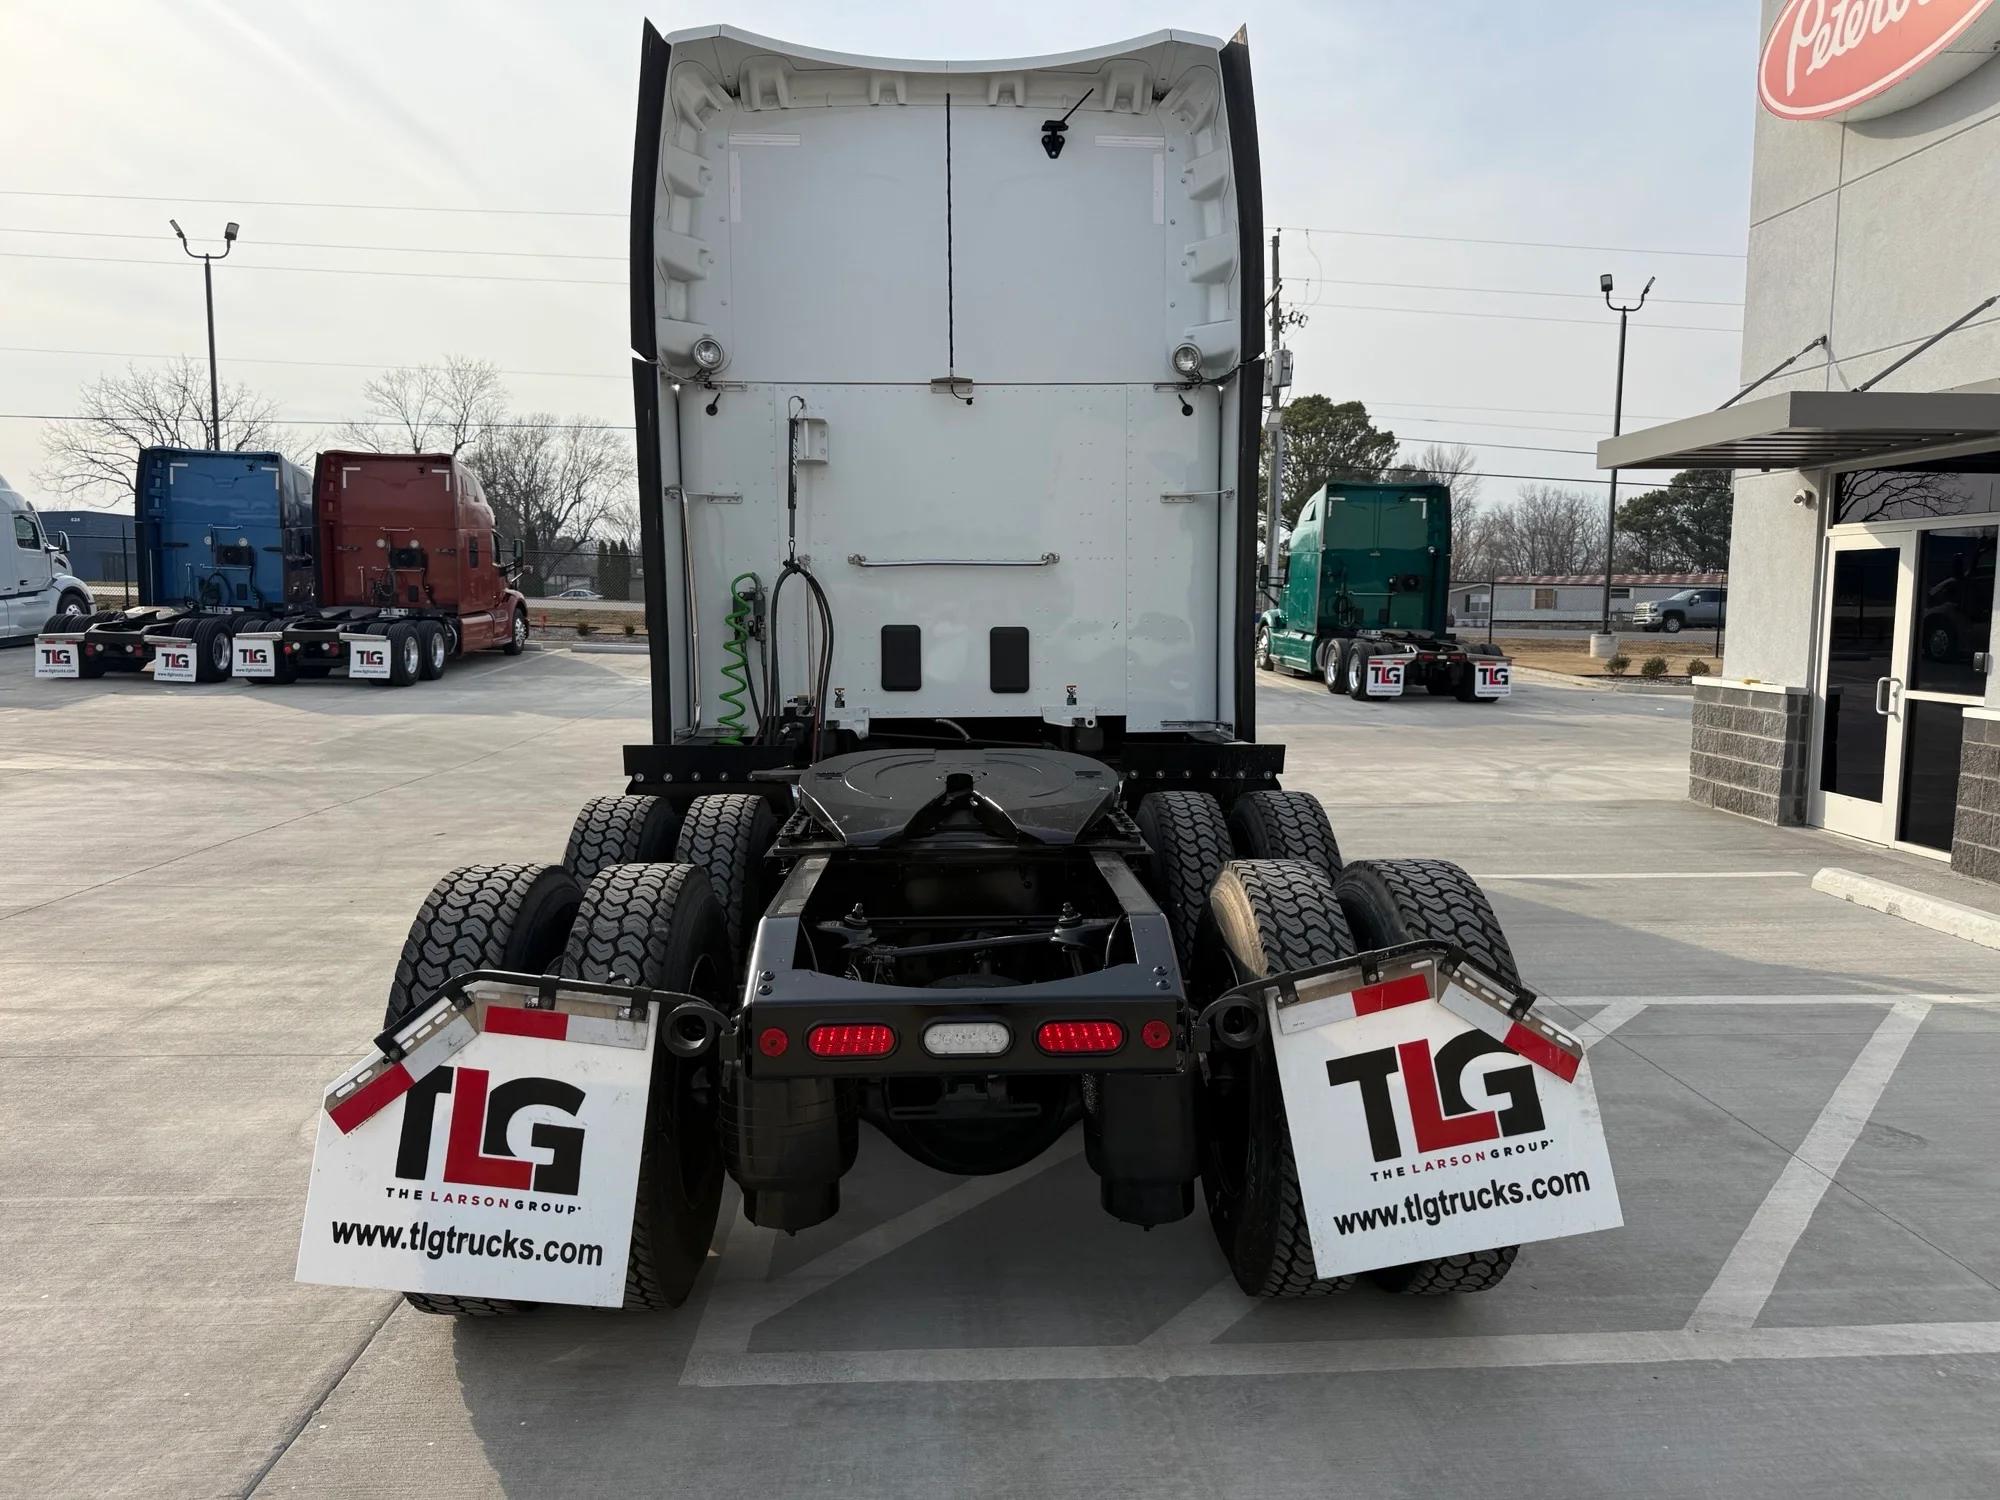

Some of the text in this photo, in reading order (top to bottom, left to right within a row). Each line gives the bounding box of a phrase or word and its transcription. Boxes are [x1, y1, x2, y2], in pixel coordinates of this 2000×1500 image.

[1786, 0, 1931, 97] Peter
[41, 649, 71, 664] TLG
[161, 653, 189, 668] TLG
[238, 649, 267, 663] TLG
[356, 651, 383, 665] TLG
[1370, 666, 1401, 684] TLG
[1478, 668, 1509, 685] TLG
[1325, 1029, 1545, 1163] TLG
[395, 1065, 586, 1196] TLG
[1370, 1166, 1405, 1182] THE
[1412, 1151, 1486, 1174] LARSON
[385, 1187, 423, 1200] THE
[430, 1191, 509, 1208] LARSON
[1333, 1169, 1591, 1236] www.tlgtrucks.com
[331, 1220, 603, 1266] www.tlgtrucks.com
